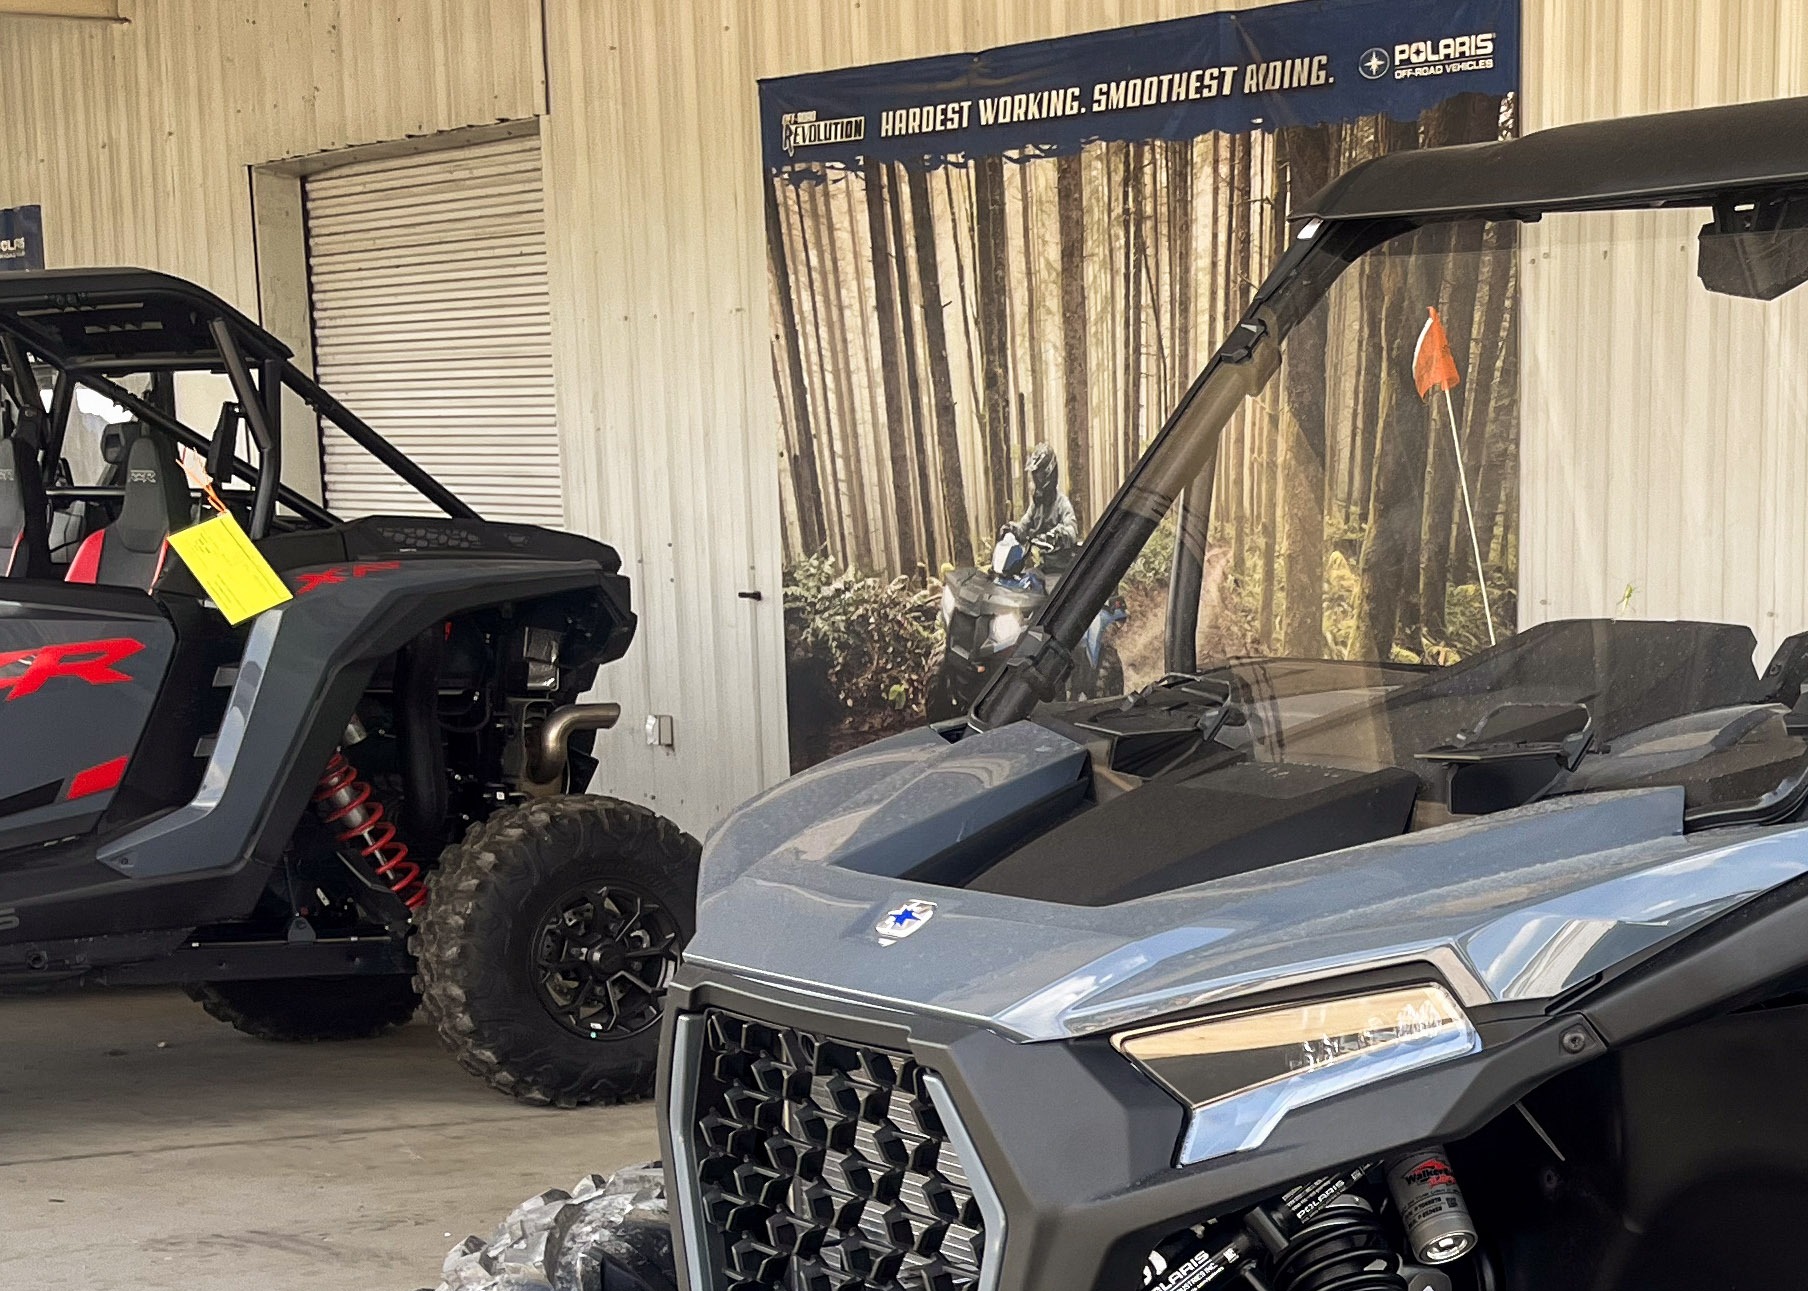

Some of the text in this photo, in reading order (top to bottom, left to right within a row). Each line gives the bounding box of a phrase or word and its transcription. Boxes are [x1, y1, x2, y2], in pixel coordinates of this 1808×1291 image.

[1394, 32, 1494, 66] POLARIS
[1394, 58, 1494, 80] OFF-ROAD VEHICLES
[880, 101, 972, 137] HARDEST
[978, 87, 1086, 126] WORKING.
[1092, 66, 1238, 112] SMOOTHEST
[782, 118, 865, 157] REVOLUTION
[295, 560, 402, 596] XP
[1296, 1179, 1345, 1219] POLARIS
